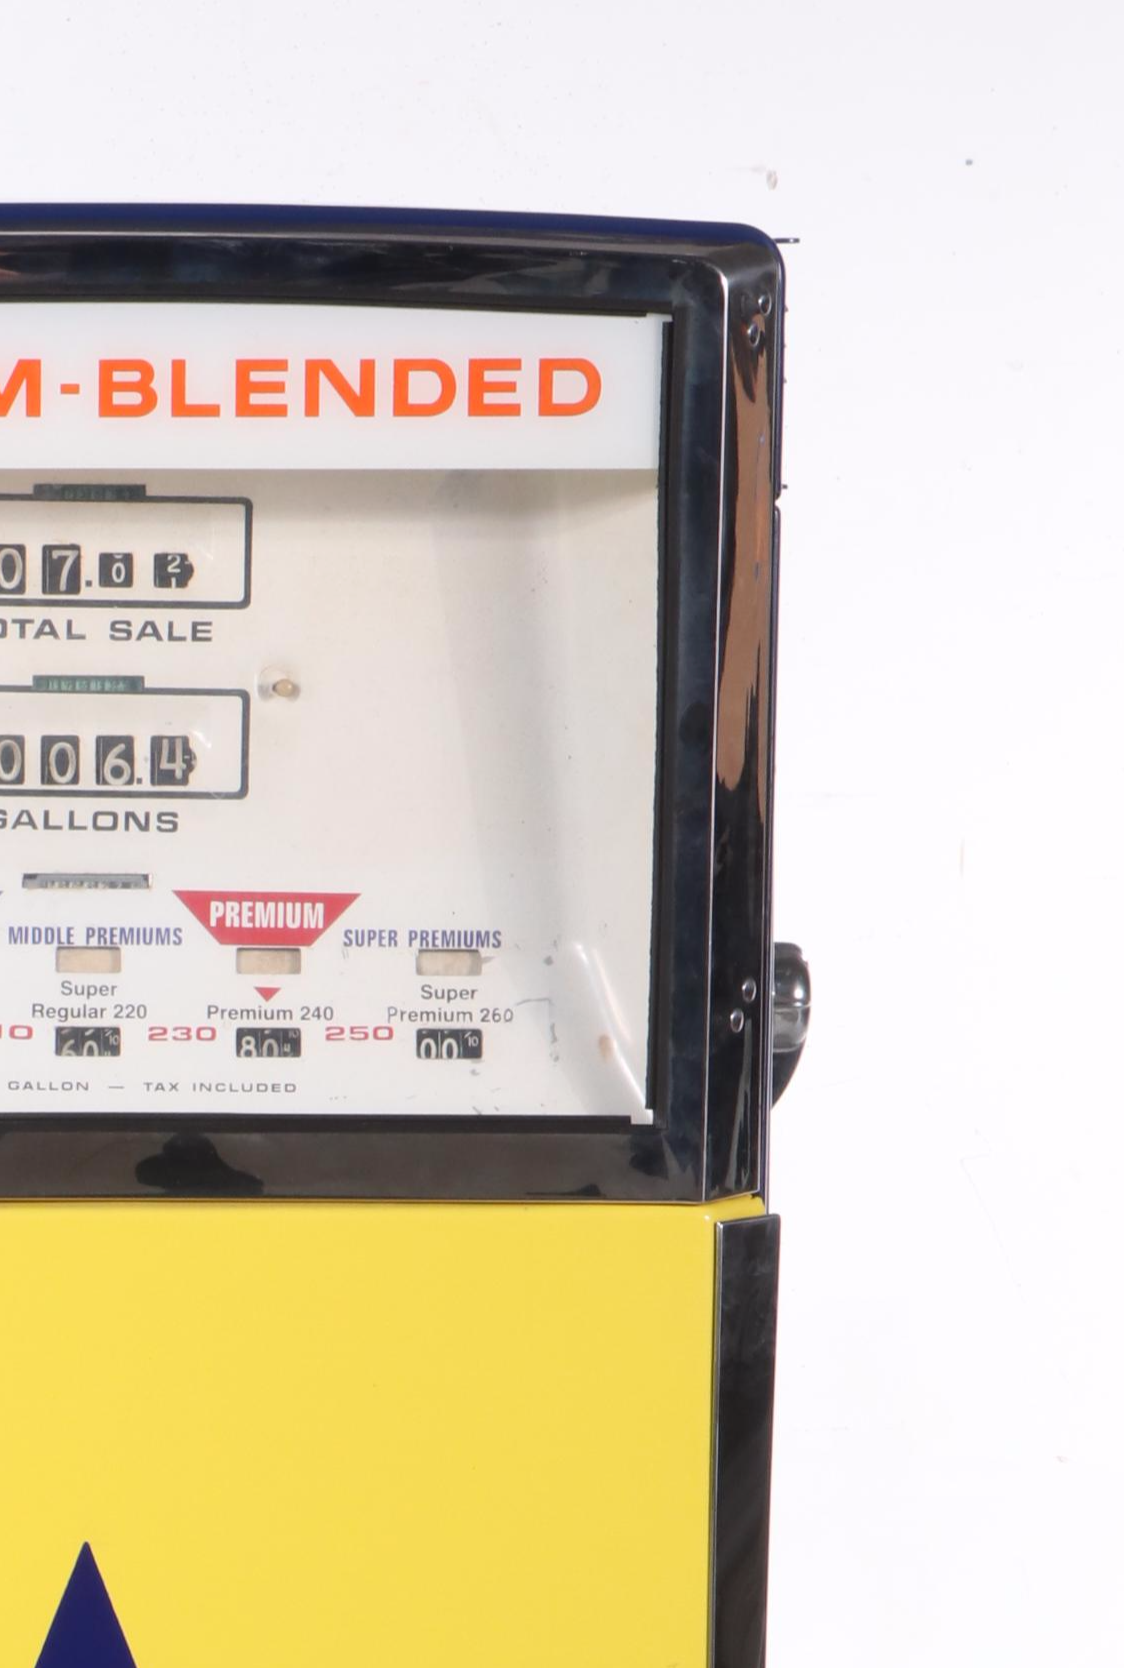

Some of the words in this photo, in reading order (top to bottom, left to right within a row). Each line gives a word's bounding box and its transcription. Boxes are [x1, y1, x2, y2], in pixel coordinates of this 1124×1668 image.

[109, 620, 212, 642] SALE
[209, 900, 325, 930] PREMIUM
[8, 926, 75, 946] MIDDLE
[84, 927, 182, 948] PREMIUMS
[343, 929, 397, 947] SUPER
[409, 930, 501, 949] PREMIUMS
[61, 980, 117, 999] Super
[421, 984, 478, 1003] Super
[32, 1003, 107, 1022] Regular
[114, 1004, 147, 1019] 220
[207, 1005, 293, 1020] Premium
[301, 1006, 333, 1021] 240
[388, 1006, 473, 1023] Premium
[480, 1008, 513, 1023] 260
[148, 1027, 216, 1041] 230
[325, 1026, 394, 1041] 250
[8, 1081, 89, 1091] GALLON
[144, 1082, 179, 1091] TAX
[193, 1083, 296, 1093] INCLUDED
